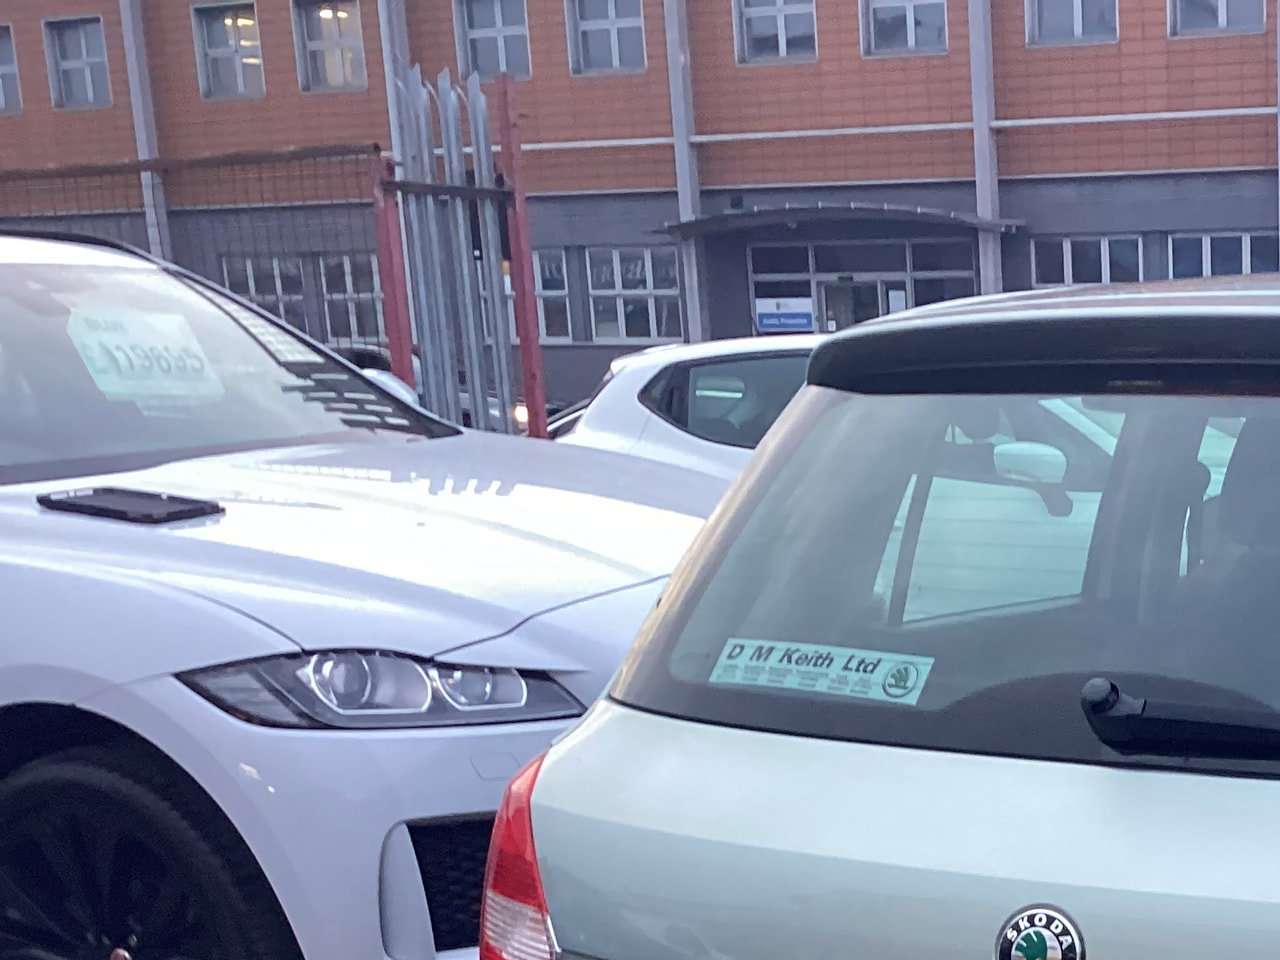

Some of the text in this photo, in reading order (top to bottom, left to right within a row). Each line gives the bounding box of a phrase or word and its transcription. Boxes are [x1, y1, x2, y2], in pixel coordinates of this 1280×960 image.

[727, 644, 882, 675] D M Keith Ltd
